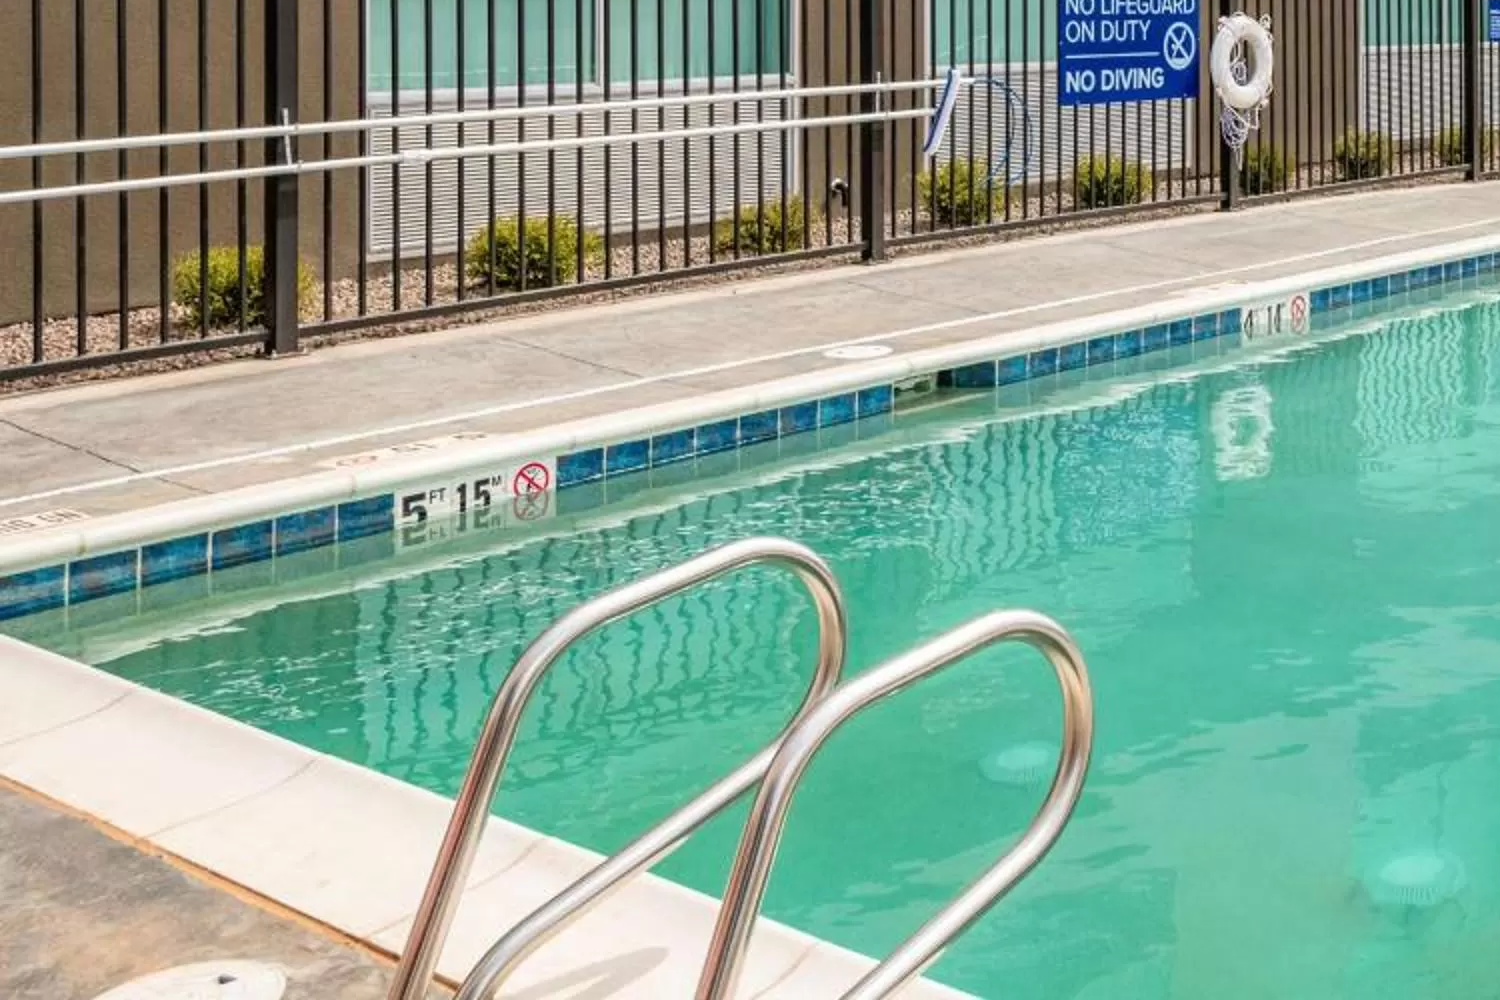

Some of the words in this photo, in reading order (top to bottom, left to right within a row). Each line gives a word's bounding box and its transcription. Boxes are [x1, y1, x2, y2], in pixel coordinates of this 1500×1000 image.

[1065, 20, 1095, 43] ON
[1101, 19, 1151, 43] DUTY
[1065, 69, 1096, 93] NO
[1101, 67, 1164, 91] DIVING
